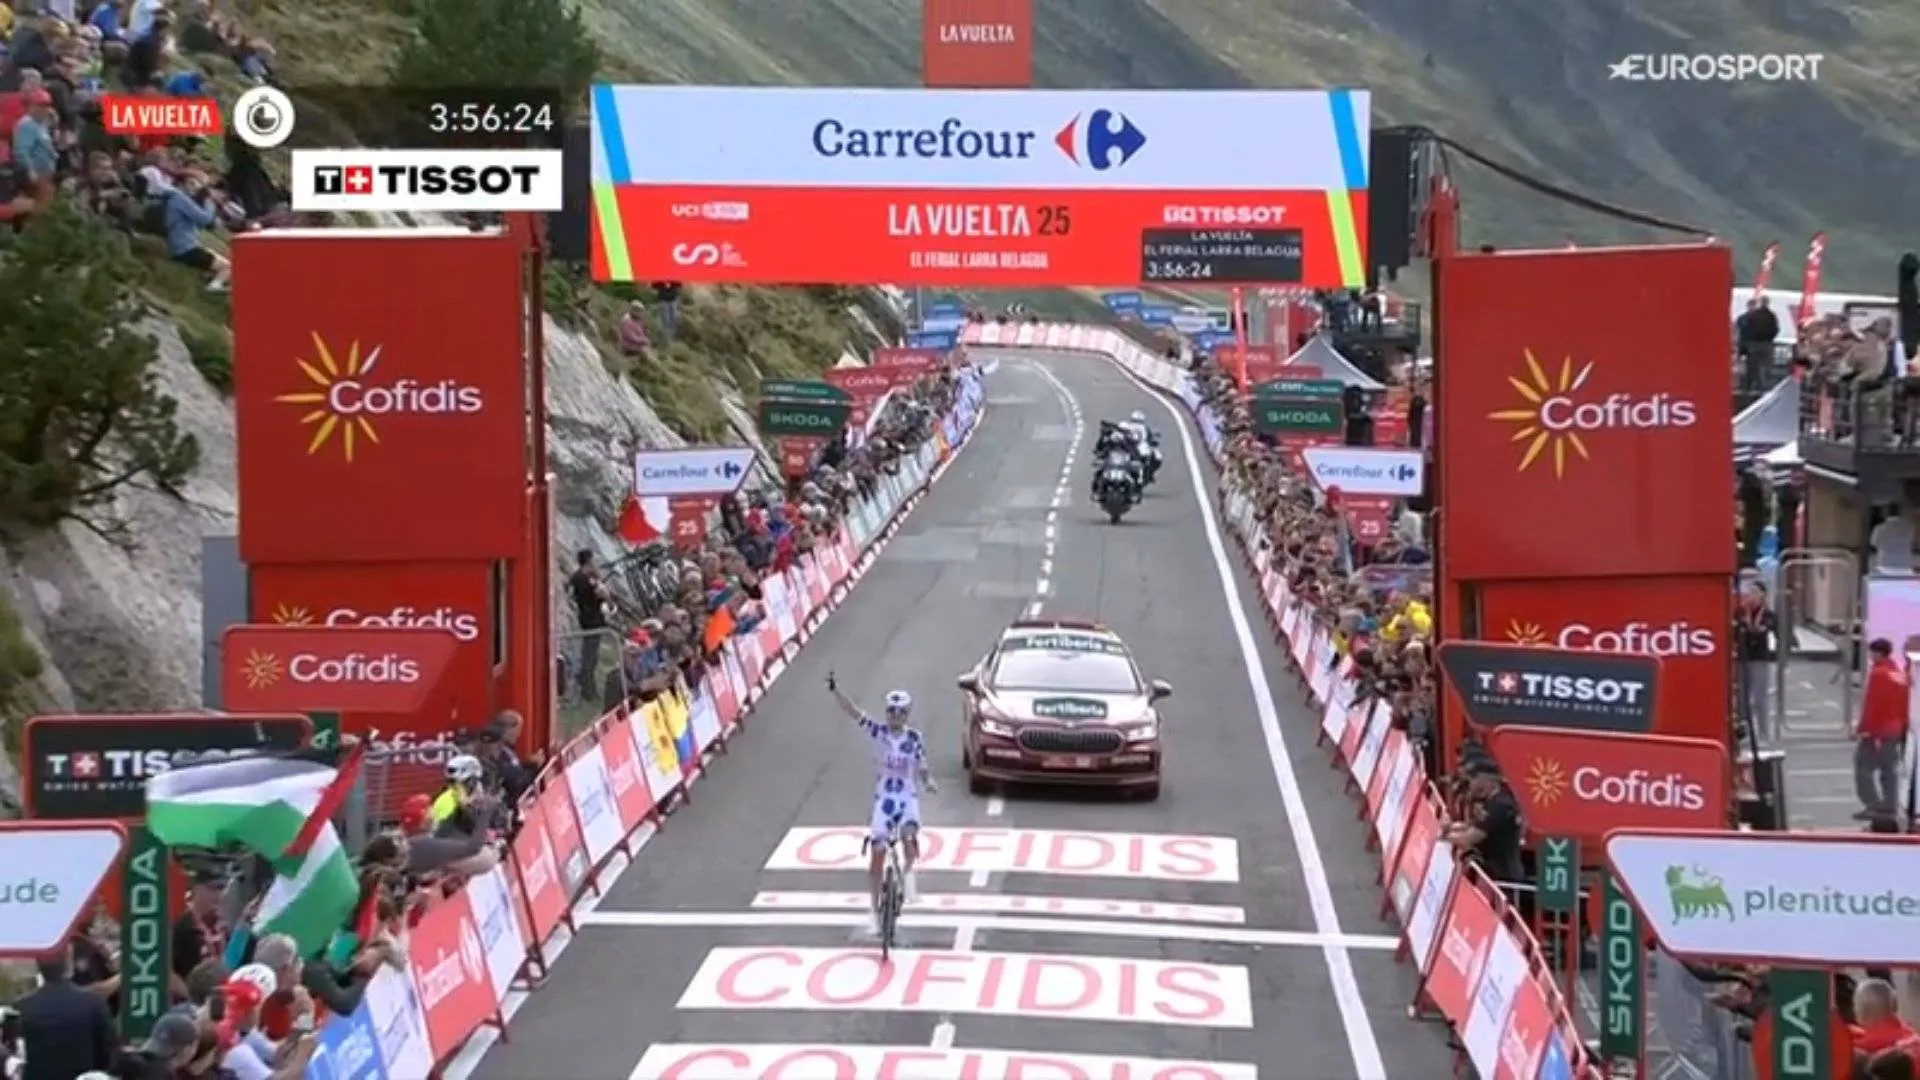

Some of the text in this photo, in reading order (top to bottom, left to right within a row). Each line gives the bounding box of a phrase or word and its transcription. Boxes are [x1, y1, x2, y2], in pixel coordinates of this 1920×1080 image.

[940, 24, 1015, 42] LA VUELTA
[812, 117, 1035, 158] Carrefour
[889, 204, 1071, 236] LA VUELTA 25
[1199, 206, 1287, 224] TISSOT
[1147, 260, 1212, 277] 3:56:24
[330, 379, 483, 413] Cofidis
[1541, 394, 1696, 428] Cofidis
[642, 462, 708, 479] Carrefour
[1559, 622, 1716, 656] Cofidis
[289, 654, 420, 683] Cofidis
[1521, 672, 1644, 704] TISSOT
[1573, 766, 1705, 810] Cofidis
[1744, 884, 1920, 917] plenitude
[715, 951, 1226, 1020] COFIDIS
